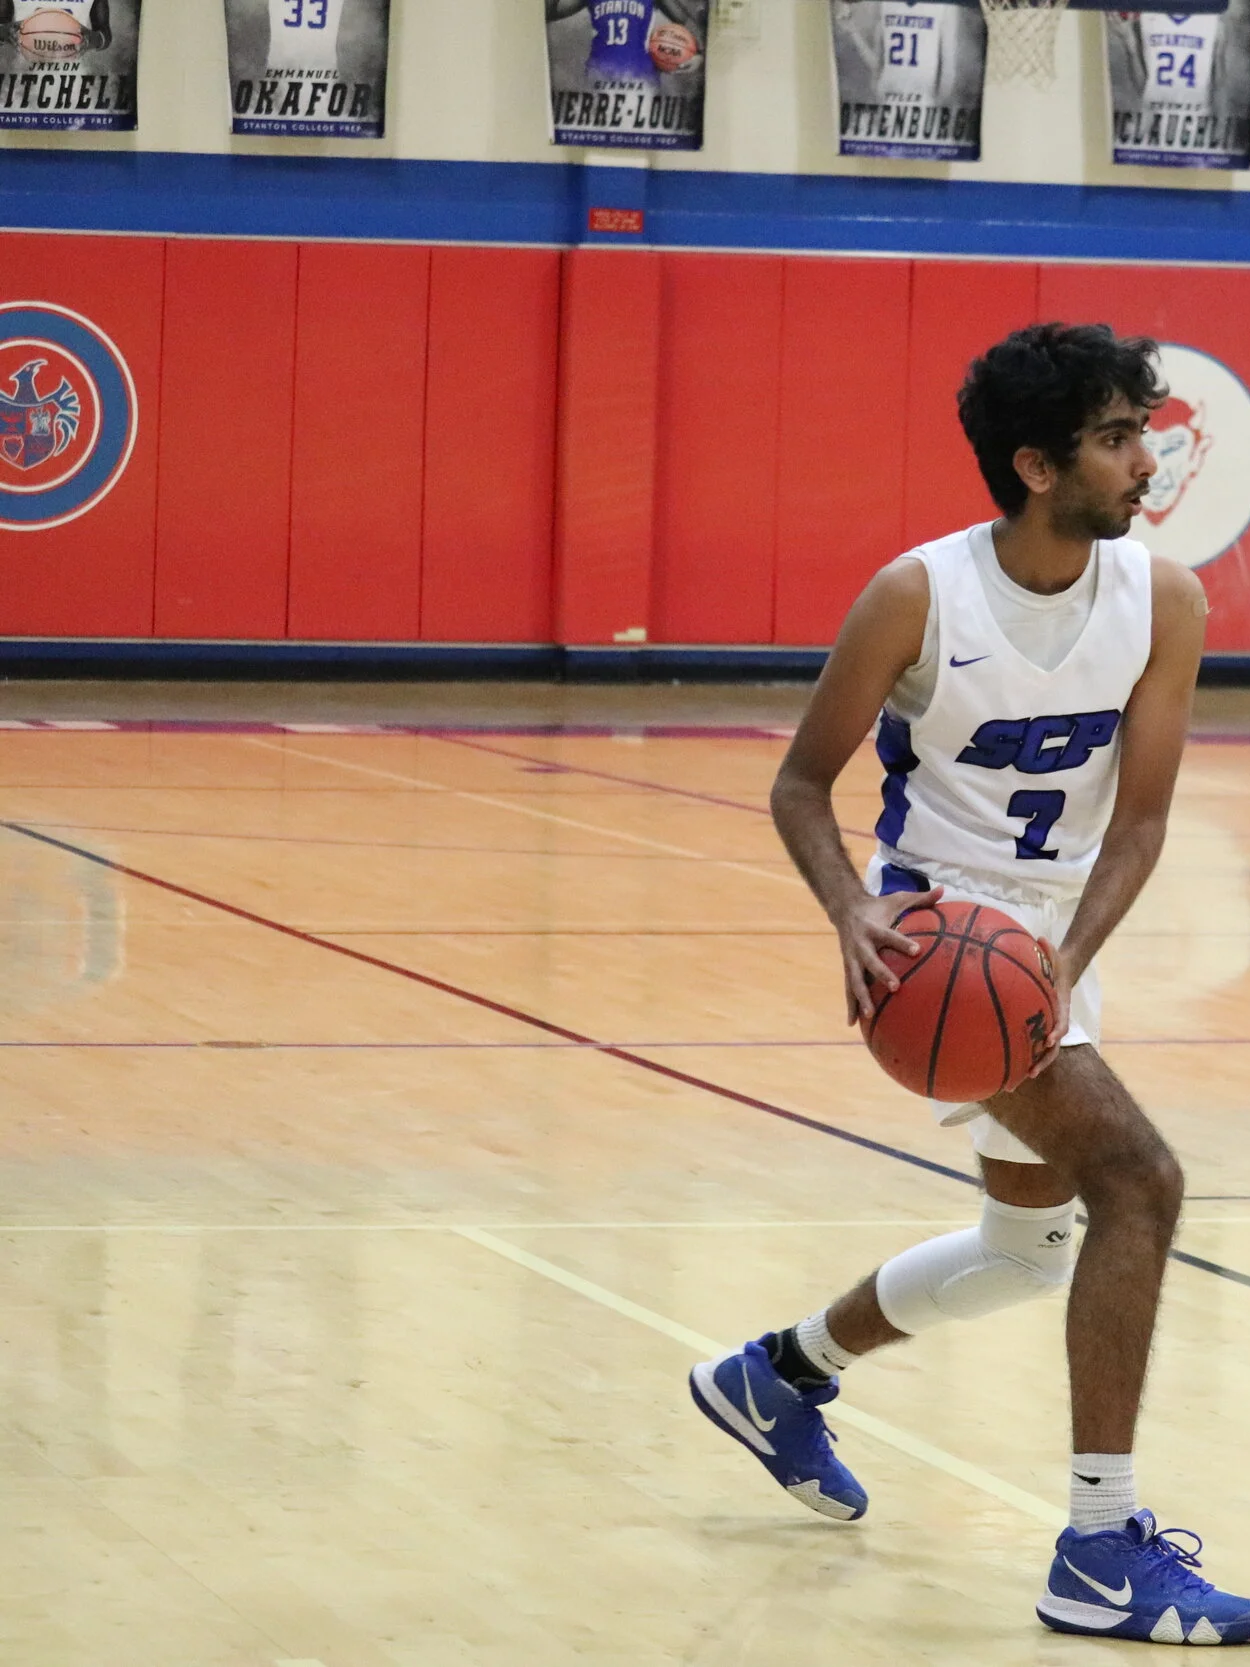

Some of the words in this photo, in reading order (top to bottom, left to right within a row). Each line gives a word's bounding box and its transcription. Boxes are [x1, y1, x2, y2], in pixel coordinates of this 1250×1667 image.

[283, 0, 328, 29] 33
[594, 0, 645, 19] STANTON
[606, 18, 629, 45] 13
[33, 39, 76, 52] Wilson
[888, 32, 918, 66] 21
[29, 62, 80, 71] JAYLON
[265, 69, 340, 79] EMMANUEL
[1157, 52, 1196, 87] 24
[0, 73, 130, 110] ITCHELL
[234, 80, 372, 118] OKAFOR
[0, 116, 37, 124] TANTON
[243, 122, 287, 130] STANTON
[292, 124, 334, 132] COLLEGE
[955, 709, 1122, 774] SCP
